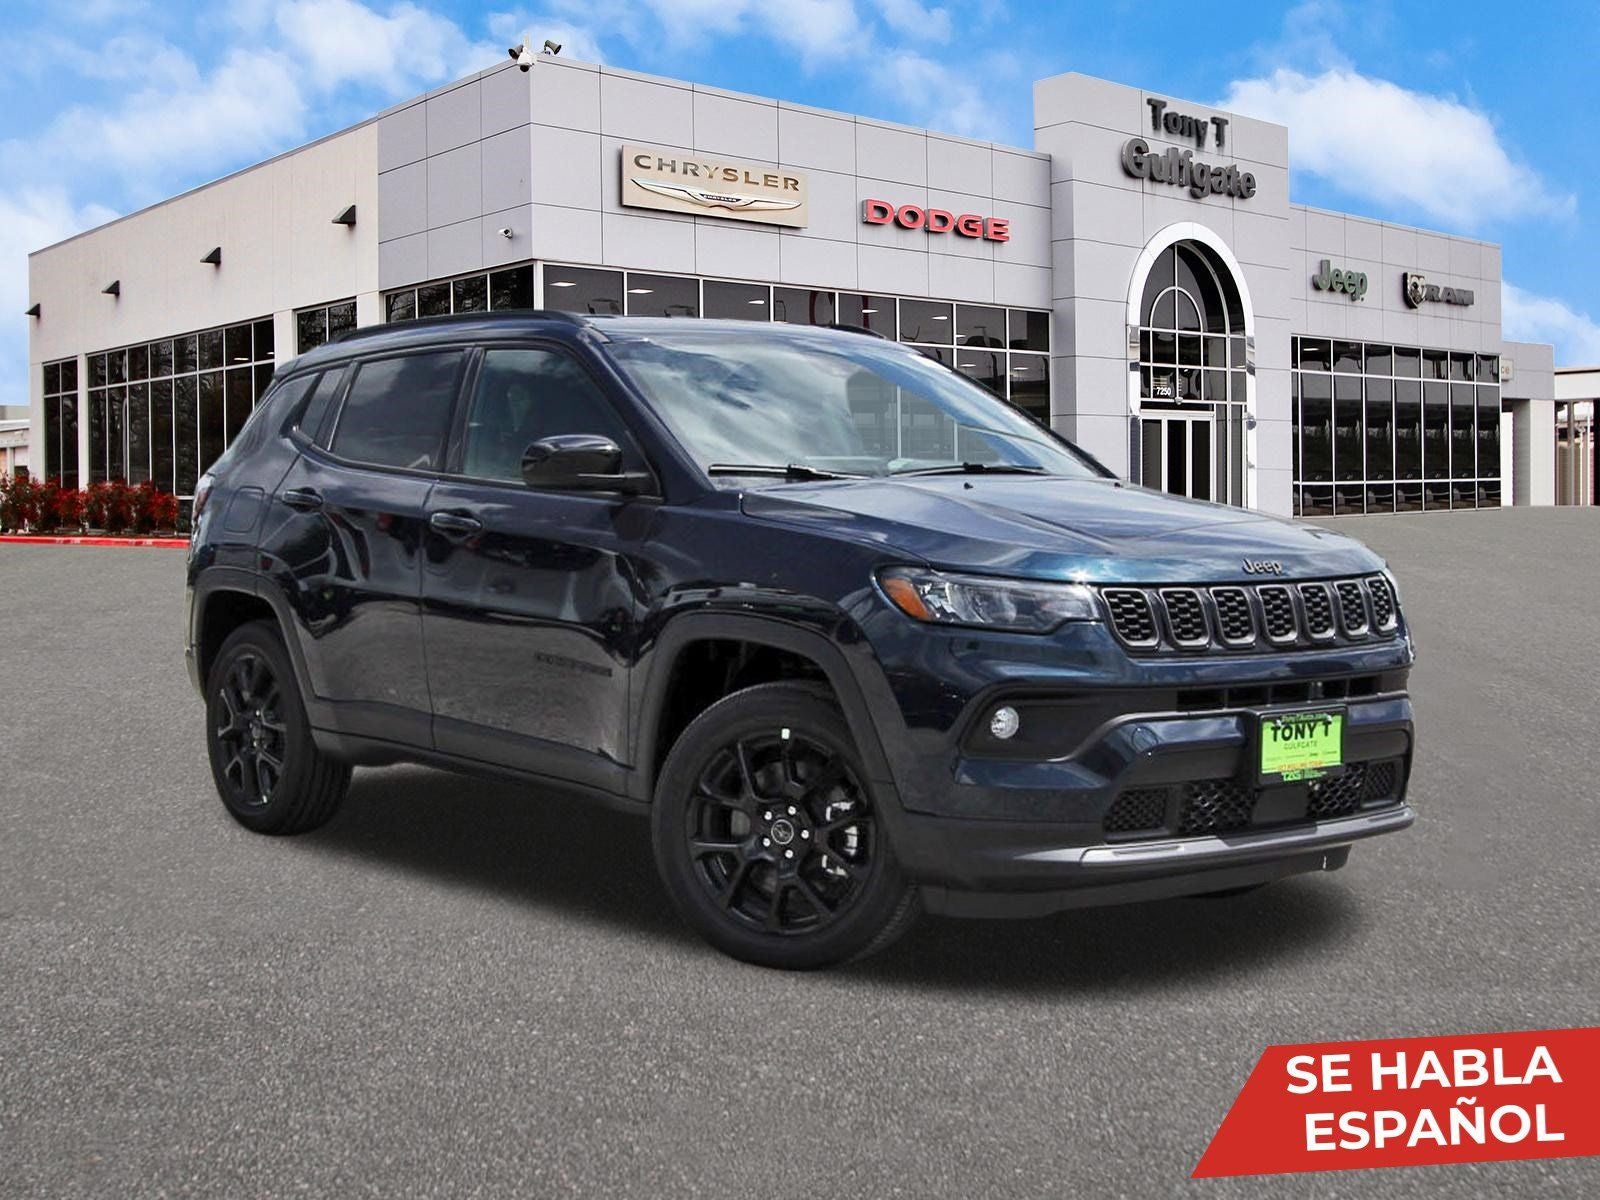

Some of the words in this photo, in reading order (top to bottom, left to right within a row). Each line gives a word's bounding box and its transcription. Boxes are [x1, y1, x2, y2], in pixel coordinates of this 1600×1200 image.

[1147, 98, 1207, 148] Tony
[1211, 117, 1229, 147] T
[634, 154, 800, 192] CHRYSLER
[1121, 138, 1256, 199] Gulfgate
[863, 199, 1011, 242] DODGE
[1312, 259, 1368, 302] Jeep
[1425, 284, 1475, 306] RAM
[1156, 386, 1172, 396] 7250
[1242, 557, 1282, 576] Jeep
[1271, 721, 1317, 742] TONY
[1322, 719, 1332, 737] T
